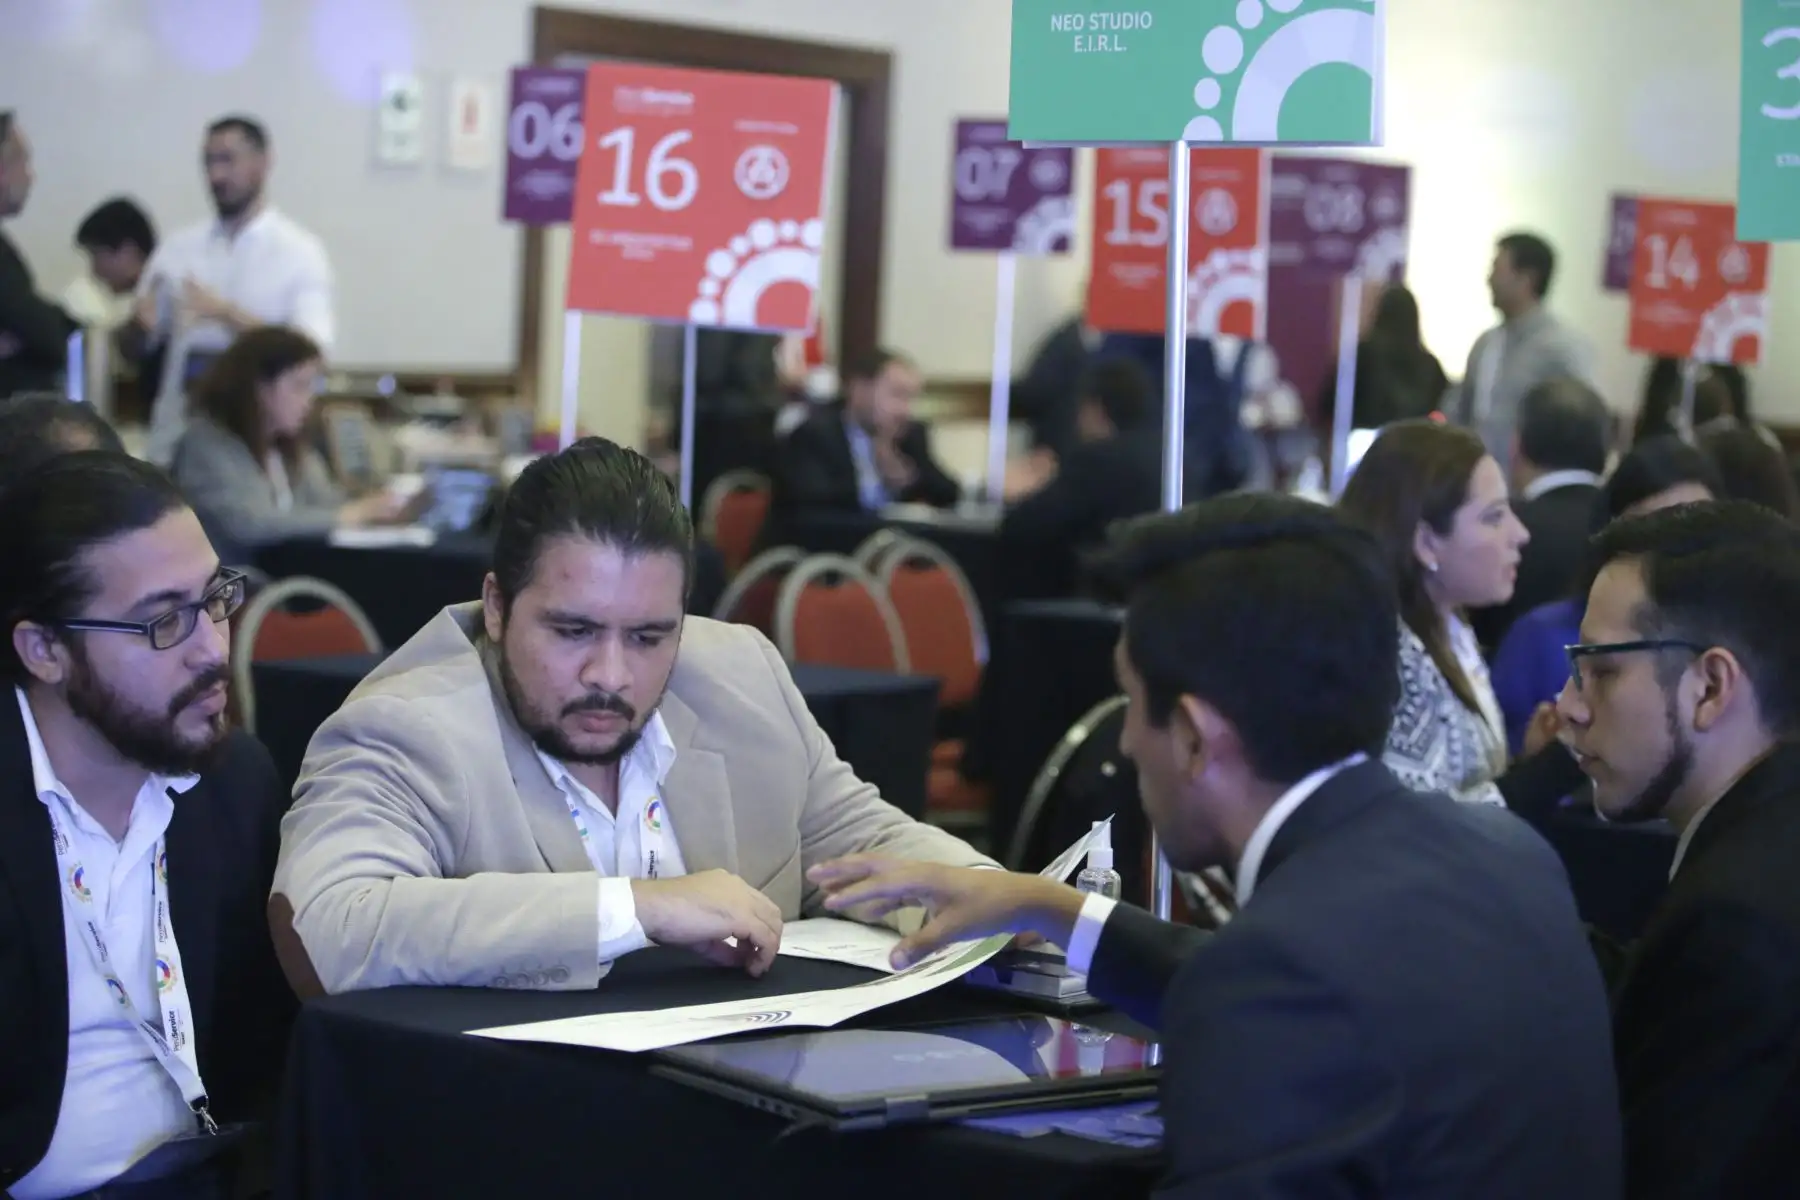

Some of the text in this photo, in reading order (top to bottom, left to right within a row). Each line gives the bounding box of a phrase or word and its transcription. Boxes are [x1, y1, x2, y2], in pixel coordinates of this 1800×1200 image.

[1051, 11, 1152, 31] NEO STUDIO
[1074, 33, 1127, 52] E.I.R.L.
[509, 101, 585, 161] 06
[597, 126, 698, 211] 16
[956, 147, 1021, 201] 07
[1103, 178, 1168, 247] 15
[1643, 233, 1700, 290] 14
